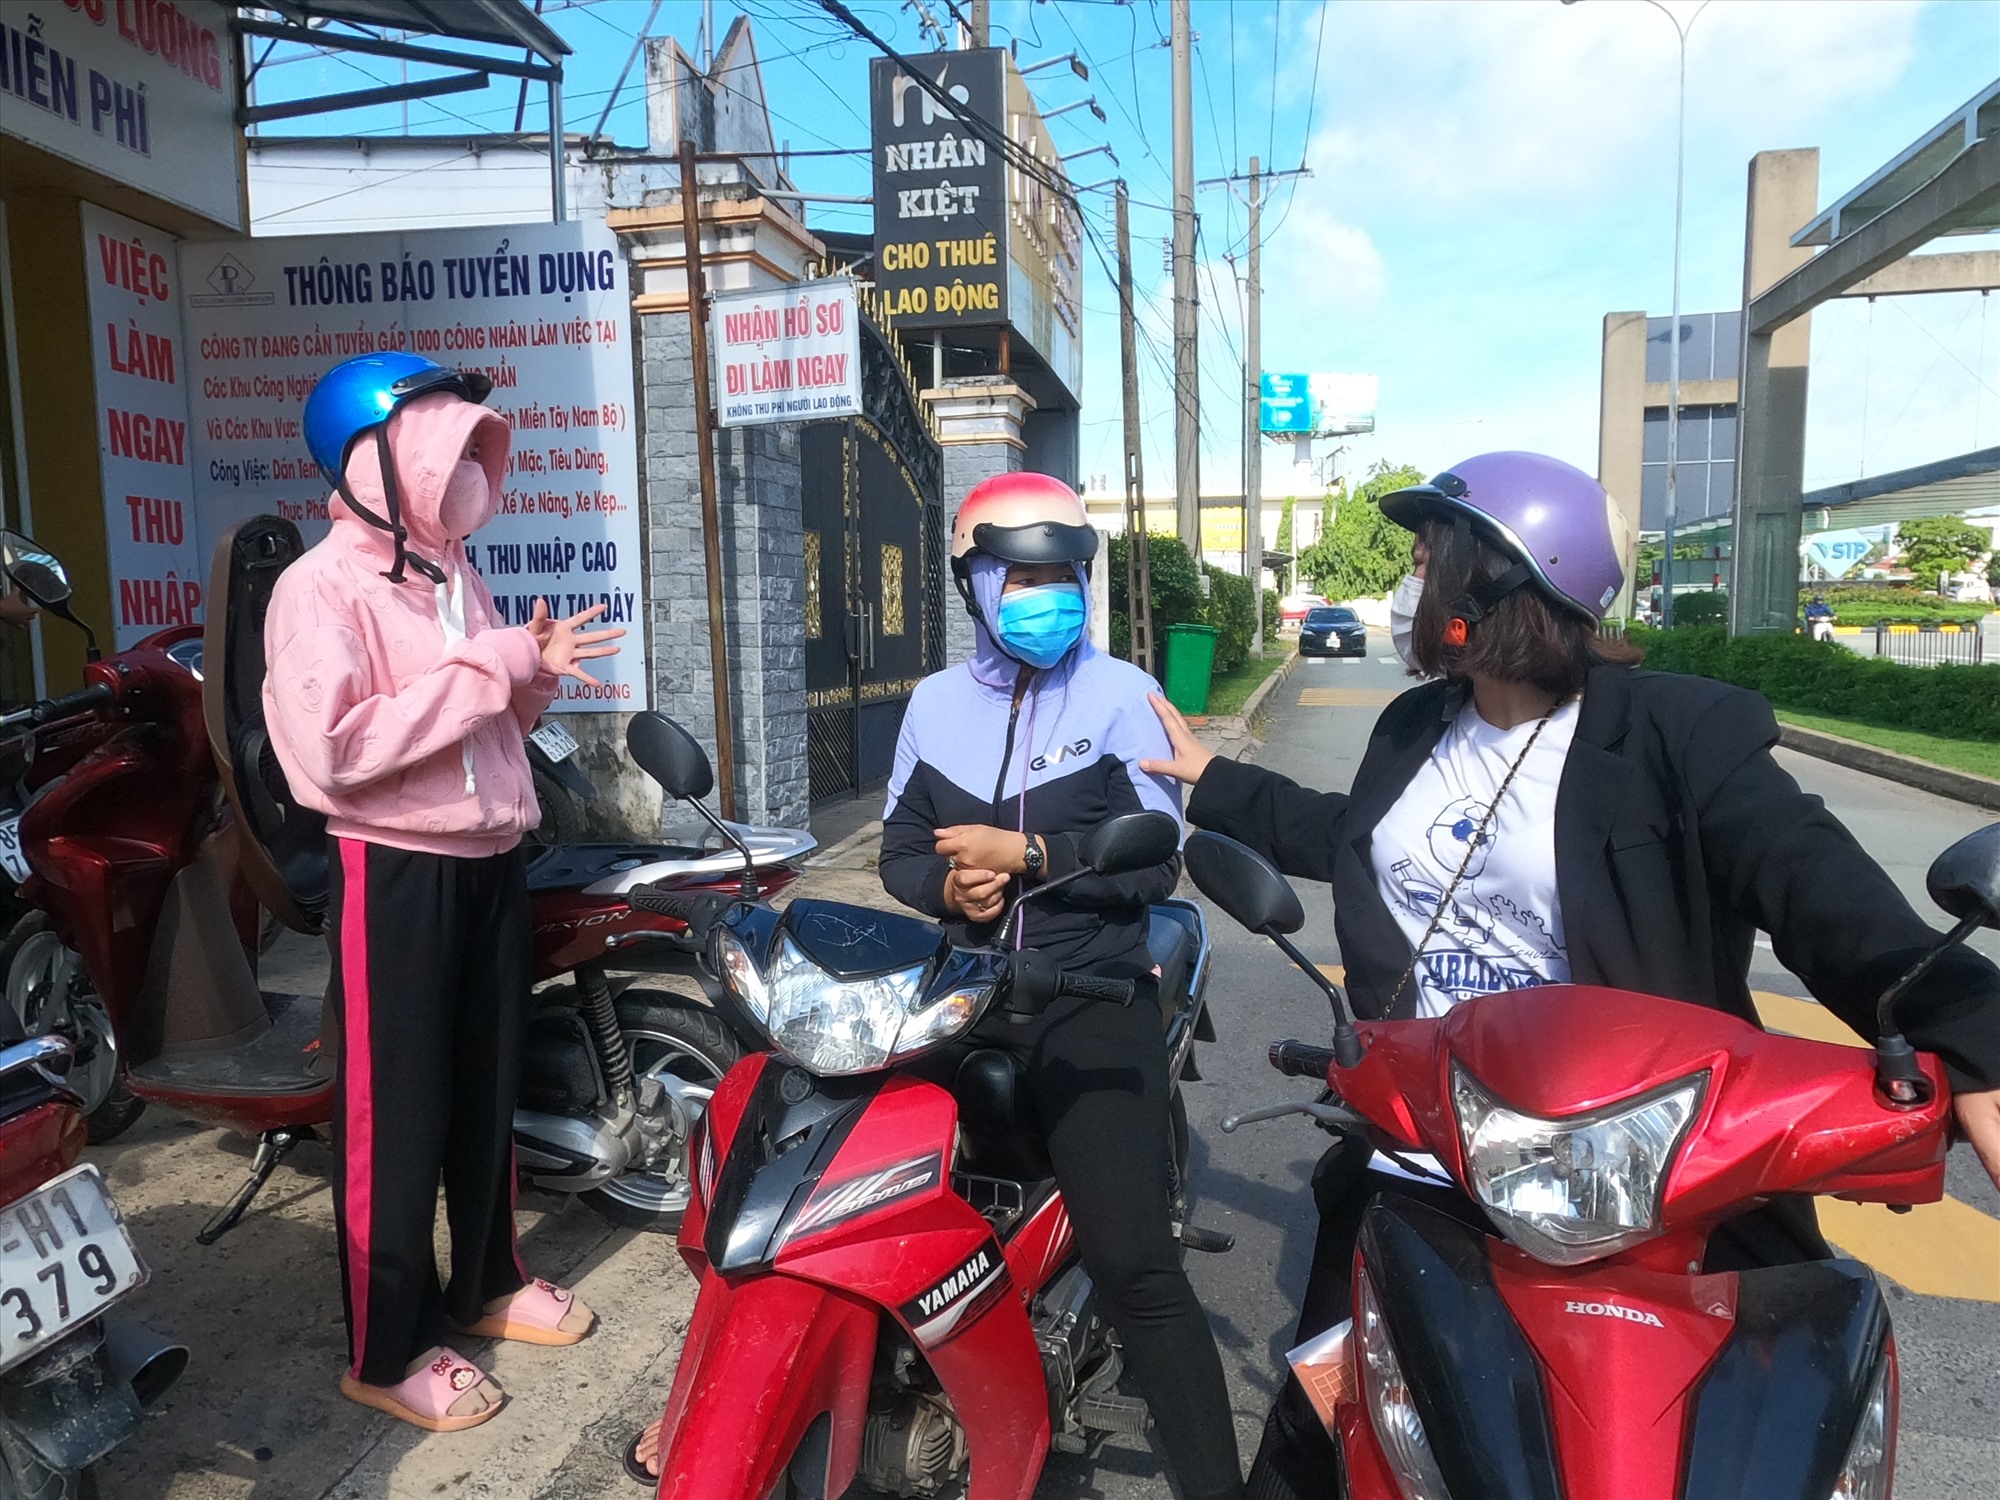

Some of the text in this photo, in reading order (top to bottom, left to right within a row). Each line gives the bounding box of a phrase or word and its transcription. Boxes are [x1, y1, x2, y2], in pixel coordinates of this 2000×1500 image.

[0, 13, 149, 156] IỄN PHÍ
[885, 132, 986, 172] NHÂN
[898, 180, 980, 222] KIỆT
[98, 234, 169, 305] VIỆC
[284, 256, 373, 306] THÔNG
[381, 252, 435, 302] BÁO
[443, 239, 530, 300] TUYỂN
[539, 250, 615, 302] DỤNG
[882, 242, 930, 271] CHO
[935, 231, 997, 267] THUÊ
[883, 278, 999, 316] LAO ĐỘNG
[201, 315, 616, 360] CÔNG TY ĐANG CẦN TUYỂN GẤP 1000 CÔNG NHÂN LÀM VIỆC TẠI
[725, 304, 780, 350] NHẬN
[815, 299, 845, 336] SƠ
[107, 318, 176, 384] LÀM
[203, 376, 228, 400] Các
[230, 376, 252, 398] Khu
[254, 374, 284, 403] Công
[726, 353, 848, 396] ĐI LÀM NGAY
[207, 417, 223, 440] Và
[225, 415, 248, 439] Các
[251, 418, 273, 438] Khu
[275, 416, 300, 445] Vực:
[549, 404, 569, 432] Tây
[571, 405, 599, 427] Nam
[602, 402, 618, 432] Bộ
[726, 403, 753, 418] KHÔNG
[754, 403, 770, 415] THU
[786, 396, 811, 412] NGƯỜI
[812, 397, 828, 410] LAO
[829, 394, 852, 411] ĐỘNG
[107, 408, 186, 465] NGAY
[210, 460, 240, 487] Công
[242, 457, 271, 487] Việc:
[272, 457, 296, 480] Dán
[517, 449, 547, 478] Mặc,
[548, 447, 572, 471] Tiêu
[574, 446, 608, 476] Dùng,
[125, 496, 185, 546] THU
[306, 491, 331, 520] Phẩ
[501, 487, 517, 515] Xế
[520, 493, 536, 514] Xe
[538, 490, 573, 519] Nâng,
[575, 490, 591, 512] Xe
[487, 544, 521, 574] THU
[526, 536, 576, 580] NHẬP
[582, 541, 617, 572] CAO
[567, 683, 591, 700] LAO
[595, 680, 631, 702] ĐỘNG
[918, 1250, 990, 1317] YAMAHA
[1565, 1301, 1665, 1328] HONDA
